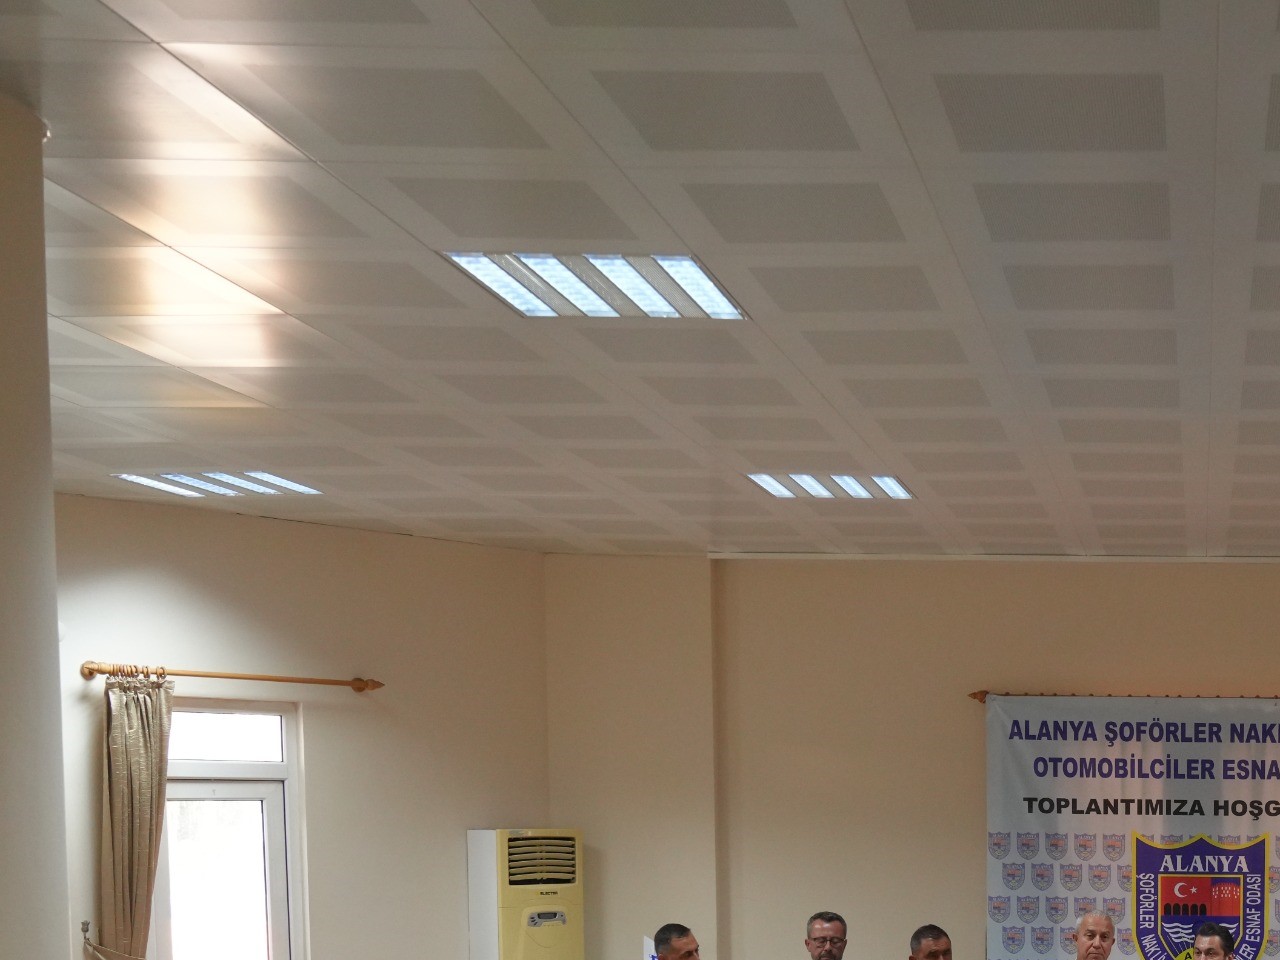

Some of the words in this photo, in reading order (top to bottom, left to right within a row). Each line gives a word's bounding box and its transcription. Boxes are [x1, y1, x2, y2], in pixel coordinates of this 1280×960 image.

[1008, 719, 1098, 742] ALANYA
[1104, 717, 1223, 747] ŞOFÖRLER
[1033, 753, 1216, 780] OTOMOBİLCİLER
[1022, 796, 1206, 816] TOPLANTIMIZA
[1159, 854, 1250, 873] ALANYA
[1136, 872, 1158, 929] ŞOFÖRLER
[1246, 873, 1262, 906] ODASI
[1245, 907, 1261, 943] ESNAF
